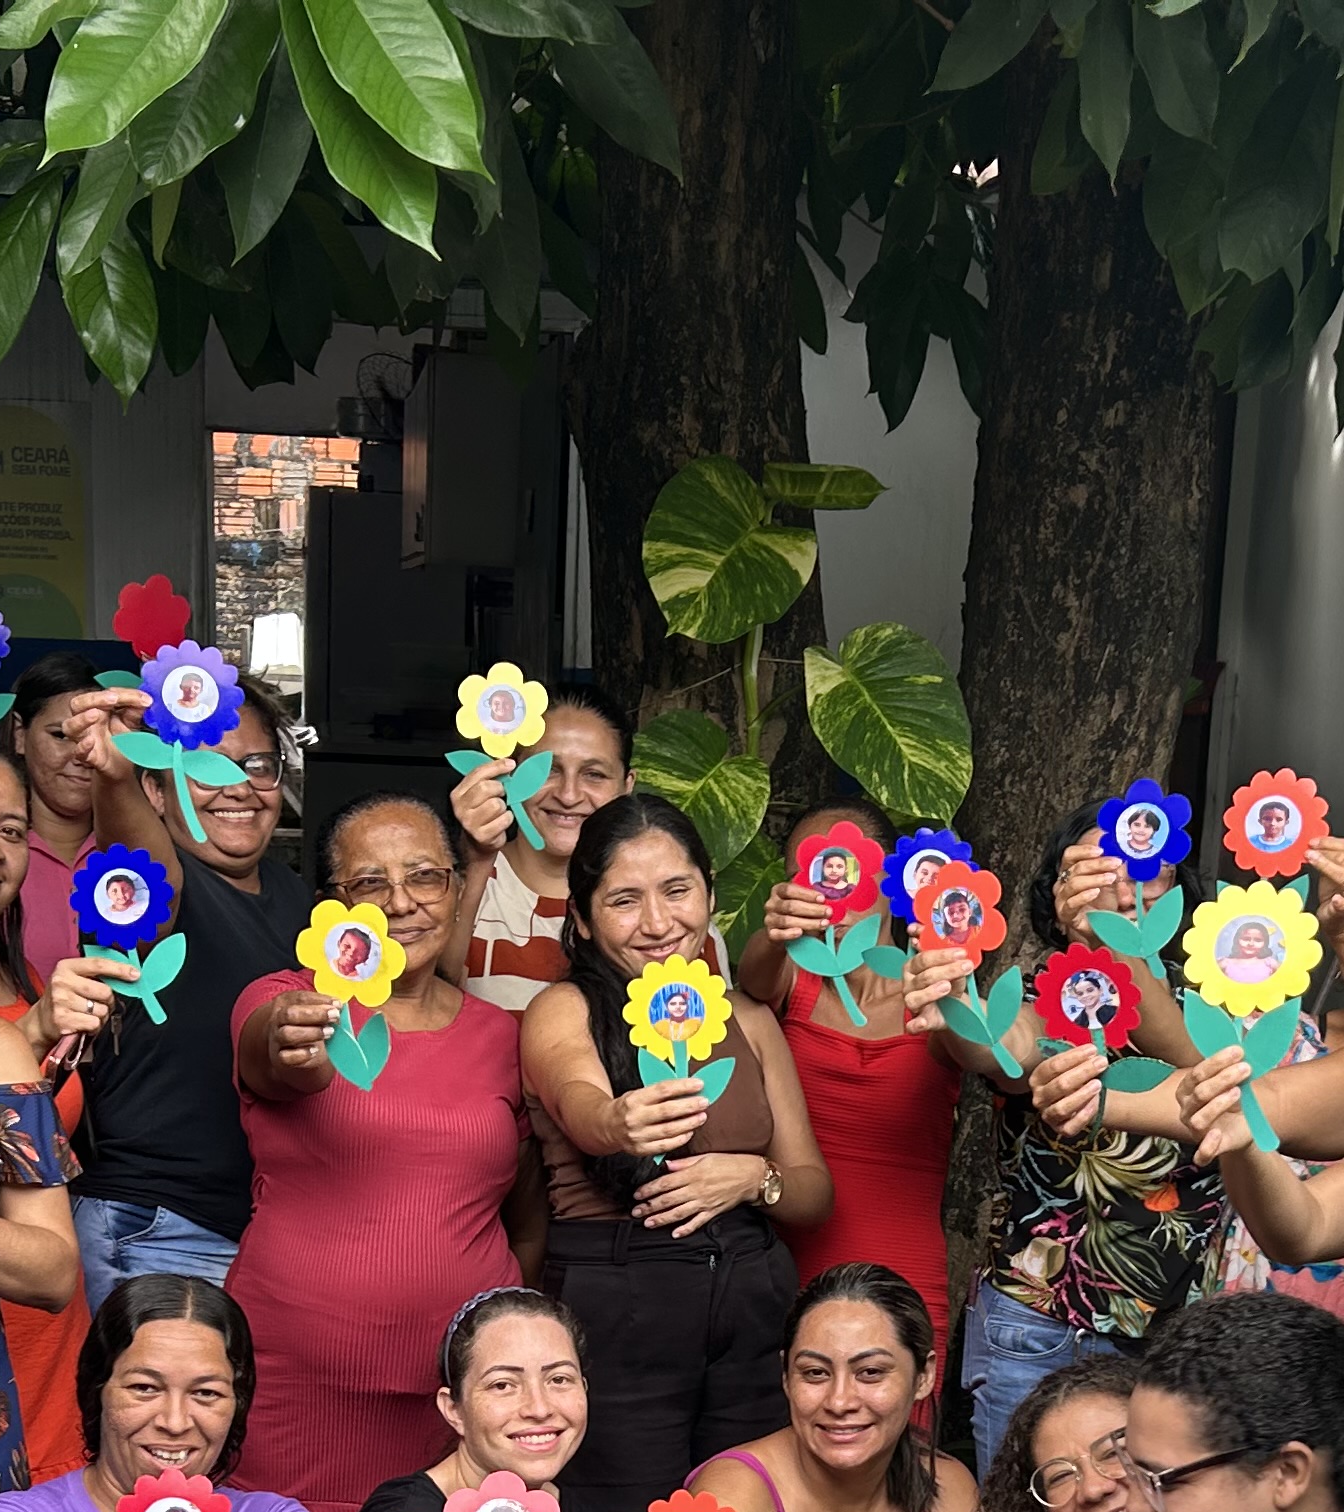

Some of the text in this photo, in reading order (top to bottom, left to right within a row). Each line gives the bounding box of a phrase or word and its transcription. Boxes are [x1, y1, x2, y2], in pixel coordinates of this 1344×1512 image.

[11, 444, 69, 463] CEARÁ
[11, 464, 72, 477] SEM FOME
